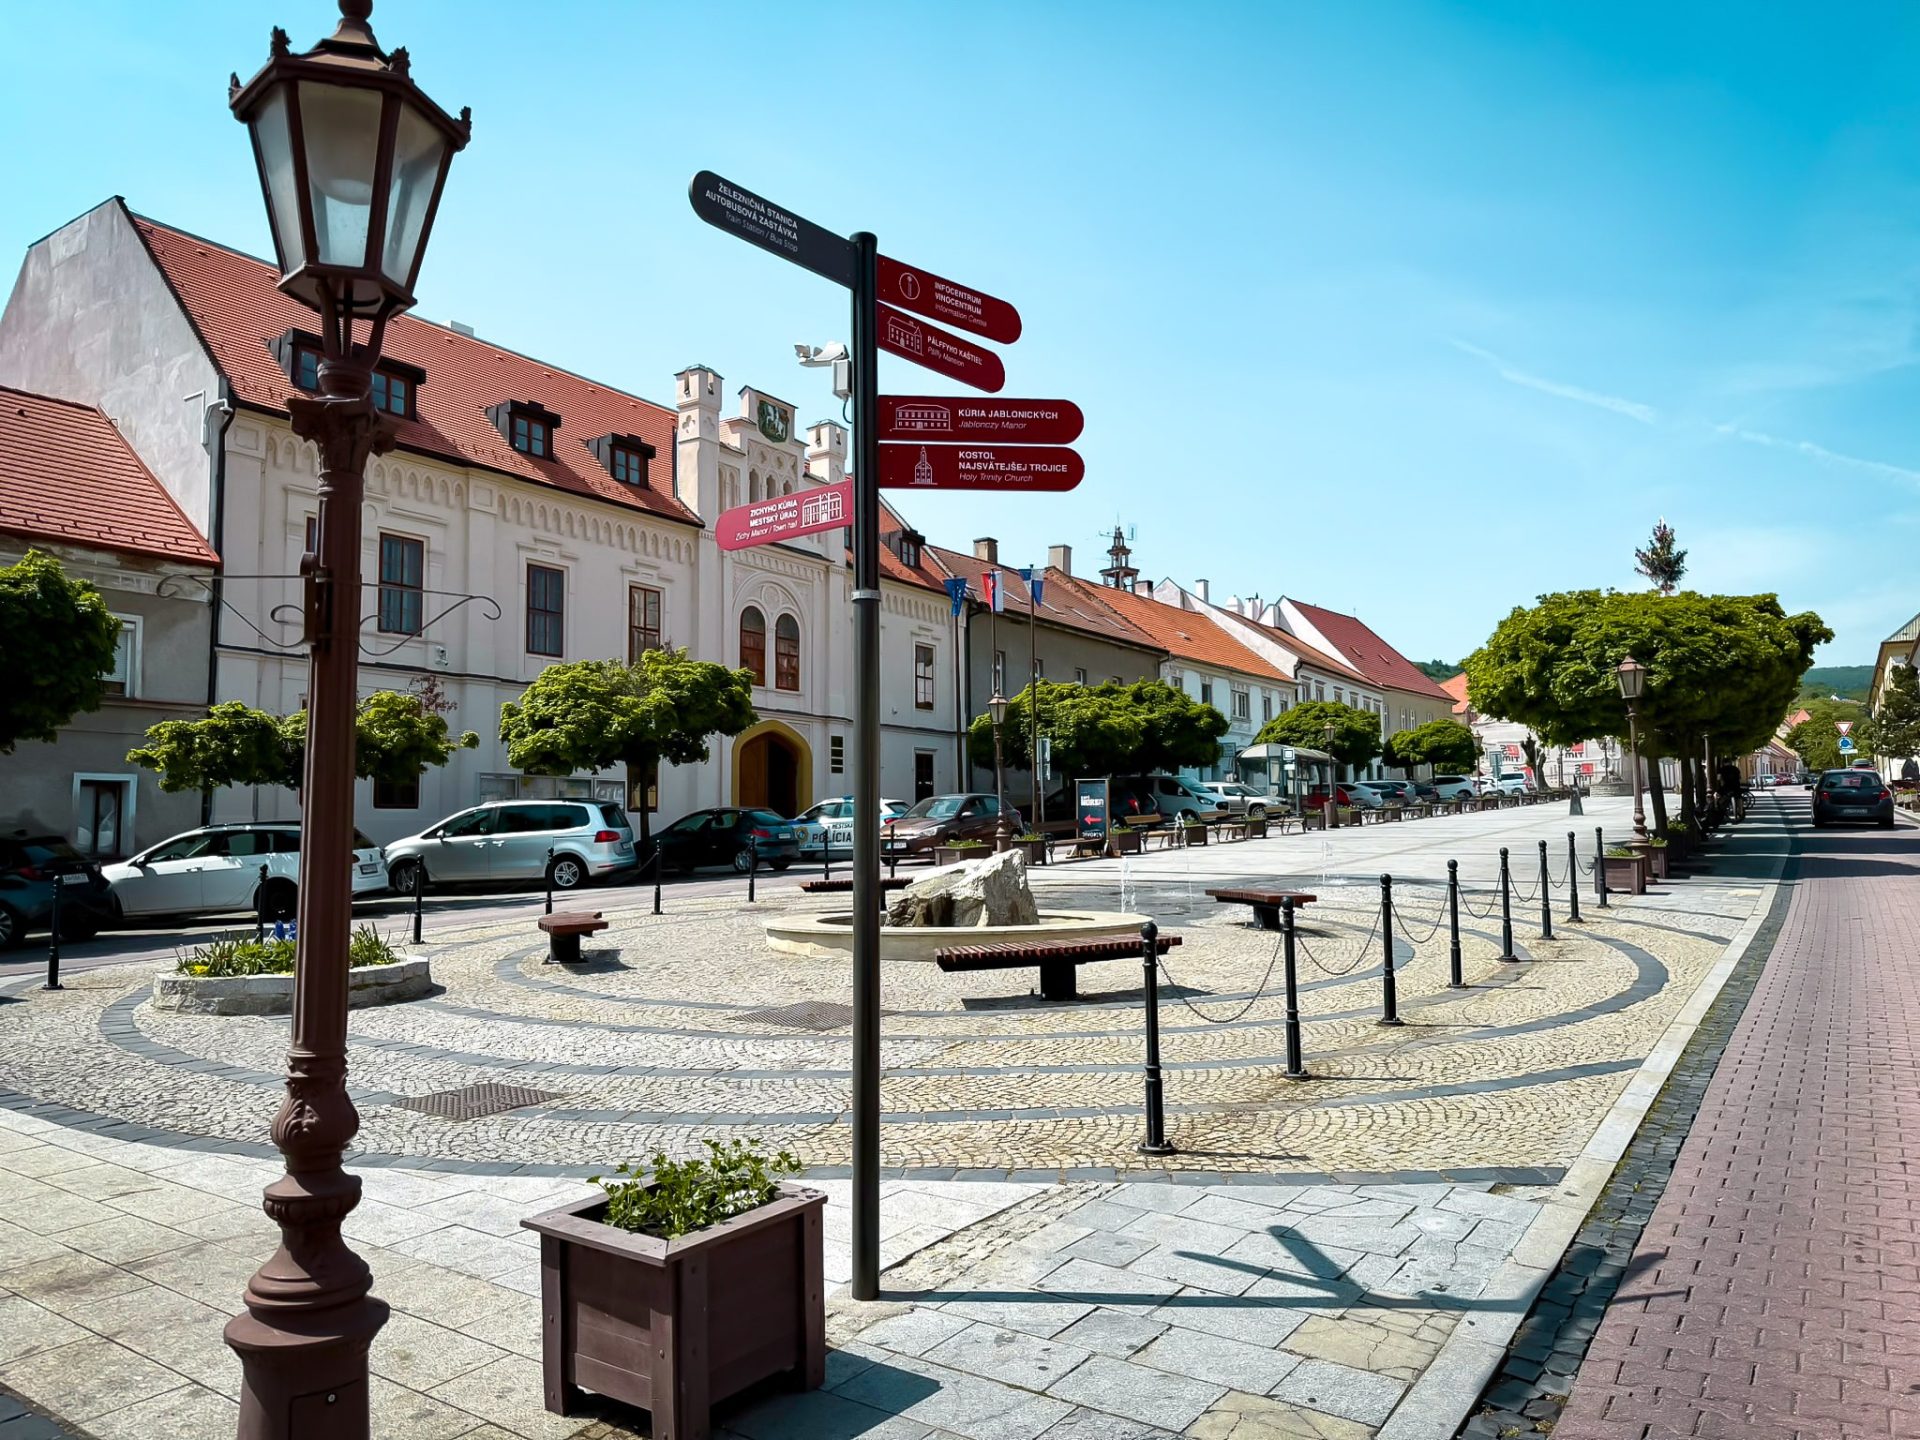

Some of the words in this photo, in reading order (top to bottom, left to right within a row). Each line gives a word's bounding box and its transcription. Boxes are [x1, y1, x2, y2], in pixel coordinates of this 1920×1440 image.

[718, 182, 766, 213] ŽELEZNIČNÁ
[766, 208, 798, 230] STANICA
[705, 189, 758, 221] AUTOBUSOVÁ
[759, 216, 798, 241] ZASTÁVKA
[726, 210, 741, 224] Train
[742, 218, 765, 236] Station
[770, 232, 783, 246] Bus
[784, 239, 798, 252] Stop
[934, 282, 982, 306] INFOCENTRUM
[934, 292, 982, 316] VINOCENTRUM
[935, 303, 968, 320] Information
[928, 335, 958, 355] PÁLFFYHO
[958, 350, 983, 366] KAŠTIEĽ
[942, 351, 965, 368] Mansion
[958, 408, 986, 418] KÚRIA
[988, 408, 1058, 420] JABLONICKÝCH
[958, 420, 999, 430] Jablonczy
[1001, 421, 1028, 430] Manor
[958, 451, 996, 460] KOSTOL
[958, 460, 1028, 472] NAJSVÄTEJŠEJ
[1029, 464, 1068, 472] TROJICE
[960, 472, 977, 482] Holy
[980, 473, 1002, 482] Trinity
[1004, 474, 1034, 482] Church
[750, 504, 777, 517] ZICHYHO
[778, 500, 798, 511] KÚRIA
[750, 513, 778, 528] MESTSKÝ
[780, 510, 798, 521] ÚRAD
